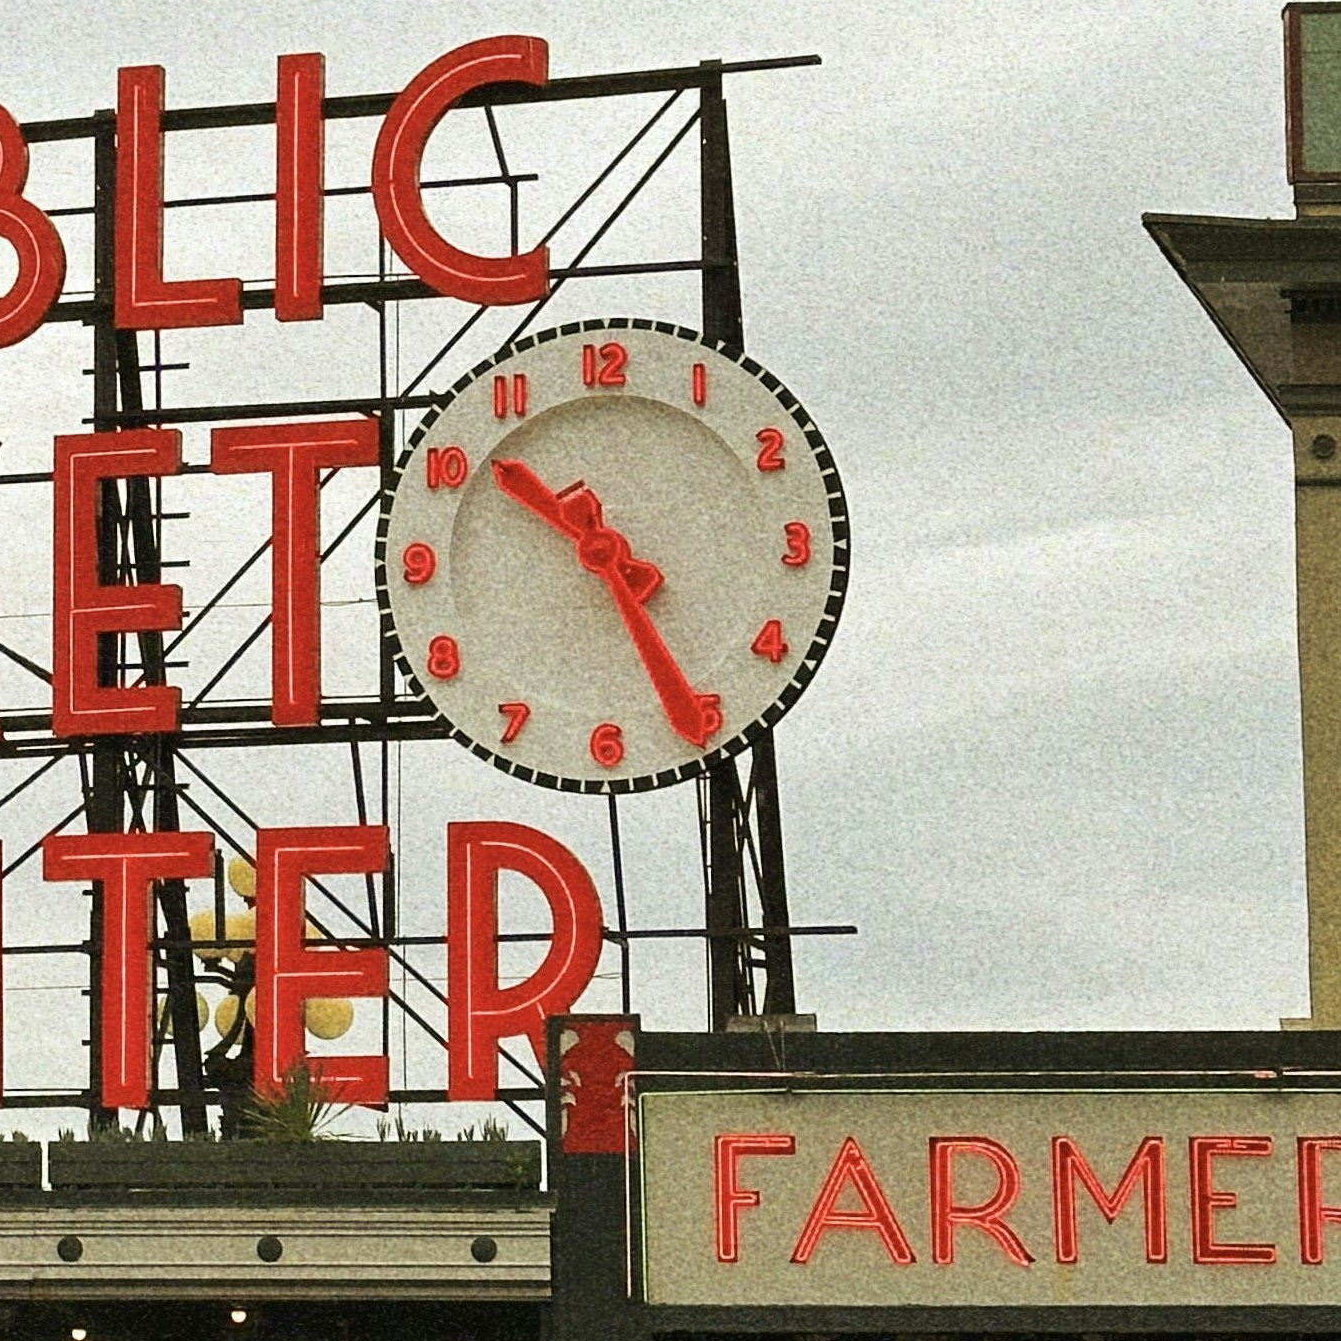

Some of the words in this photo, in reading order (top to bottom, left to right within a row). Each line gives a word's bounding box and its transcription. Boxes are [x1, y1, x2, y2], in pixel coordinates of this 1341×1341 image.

[581, 341, 628, 387] 12
[691, 363, 707, 407] 1
[493, 373, 528, 418] 11
[426, 446, 469, 490] 10
[756, 427, 785, 473] 2
[403, 541, 437, 585] 9
[782, 522, 812, 567] 3
[426, 634, 461, 681] 8
[751, 619, 789, 663] 4
[499, 702, 531, 742] 7
[589, 722, 625, 769] 6
